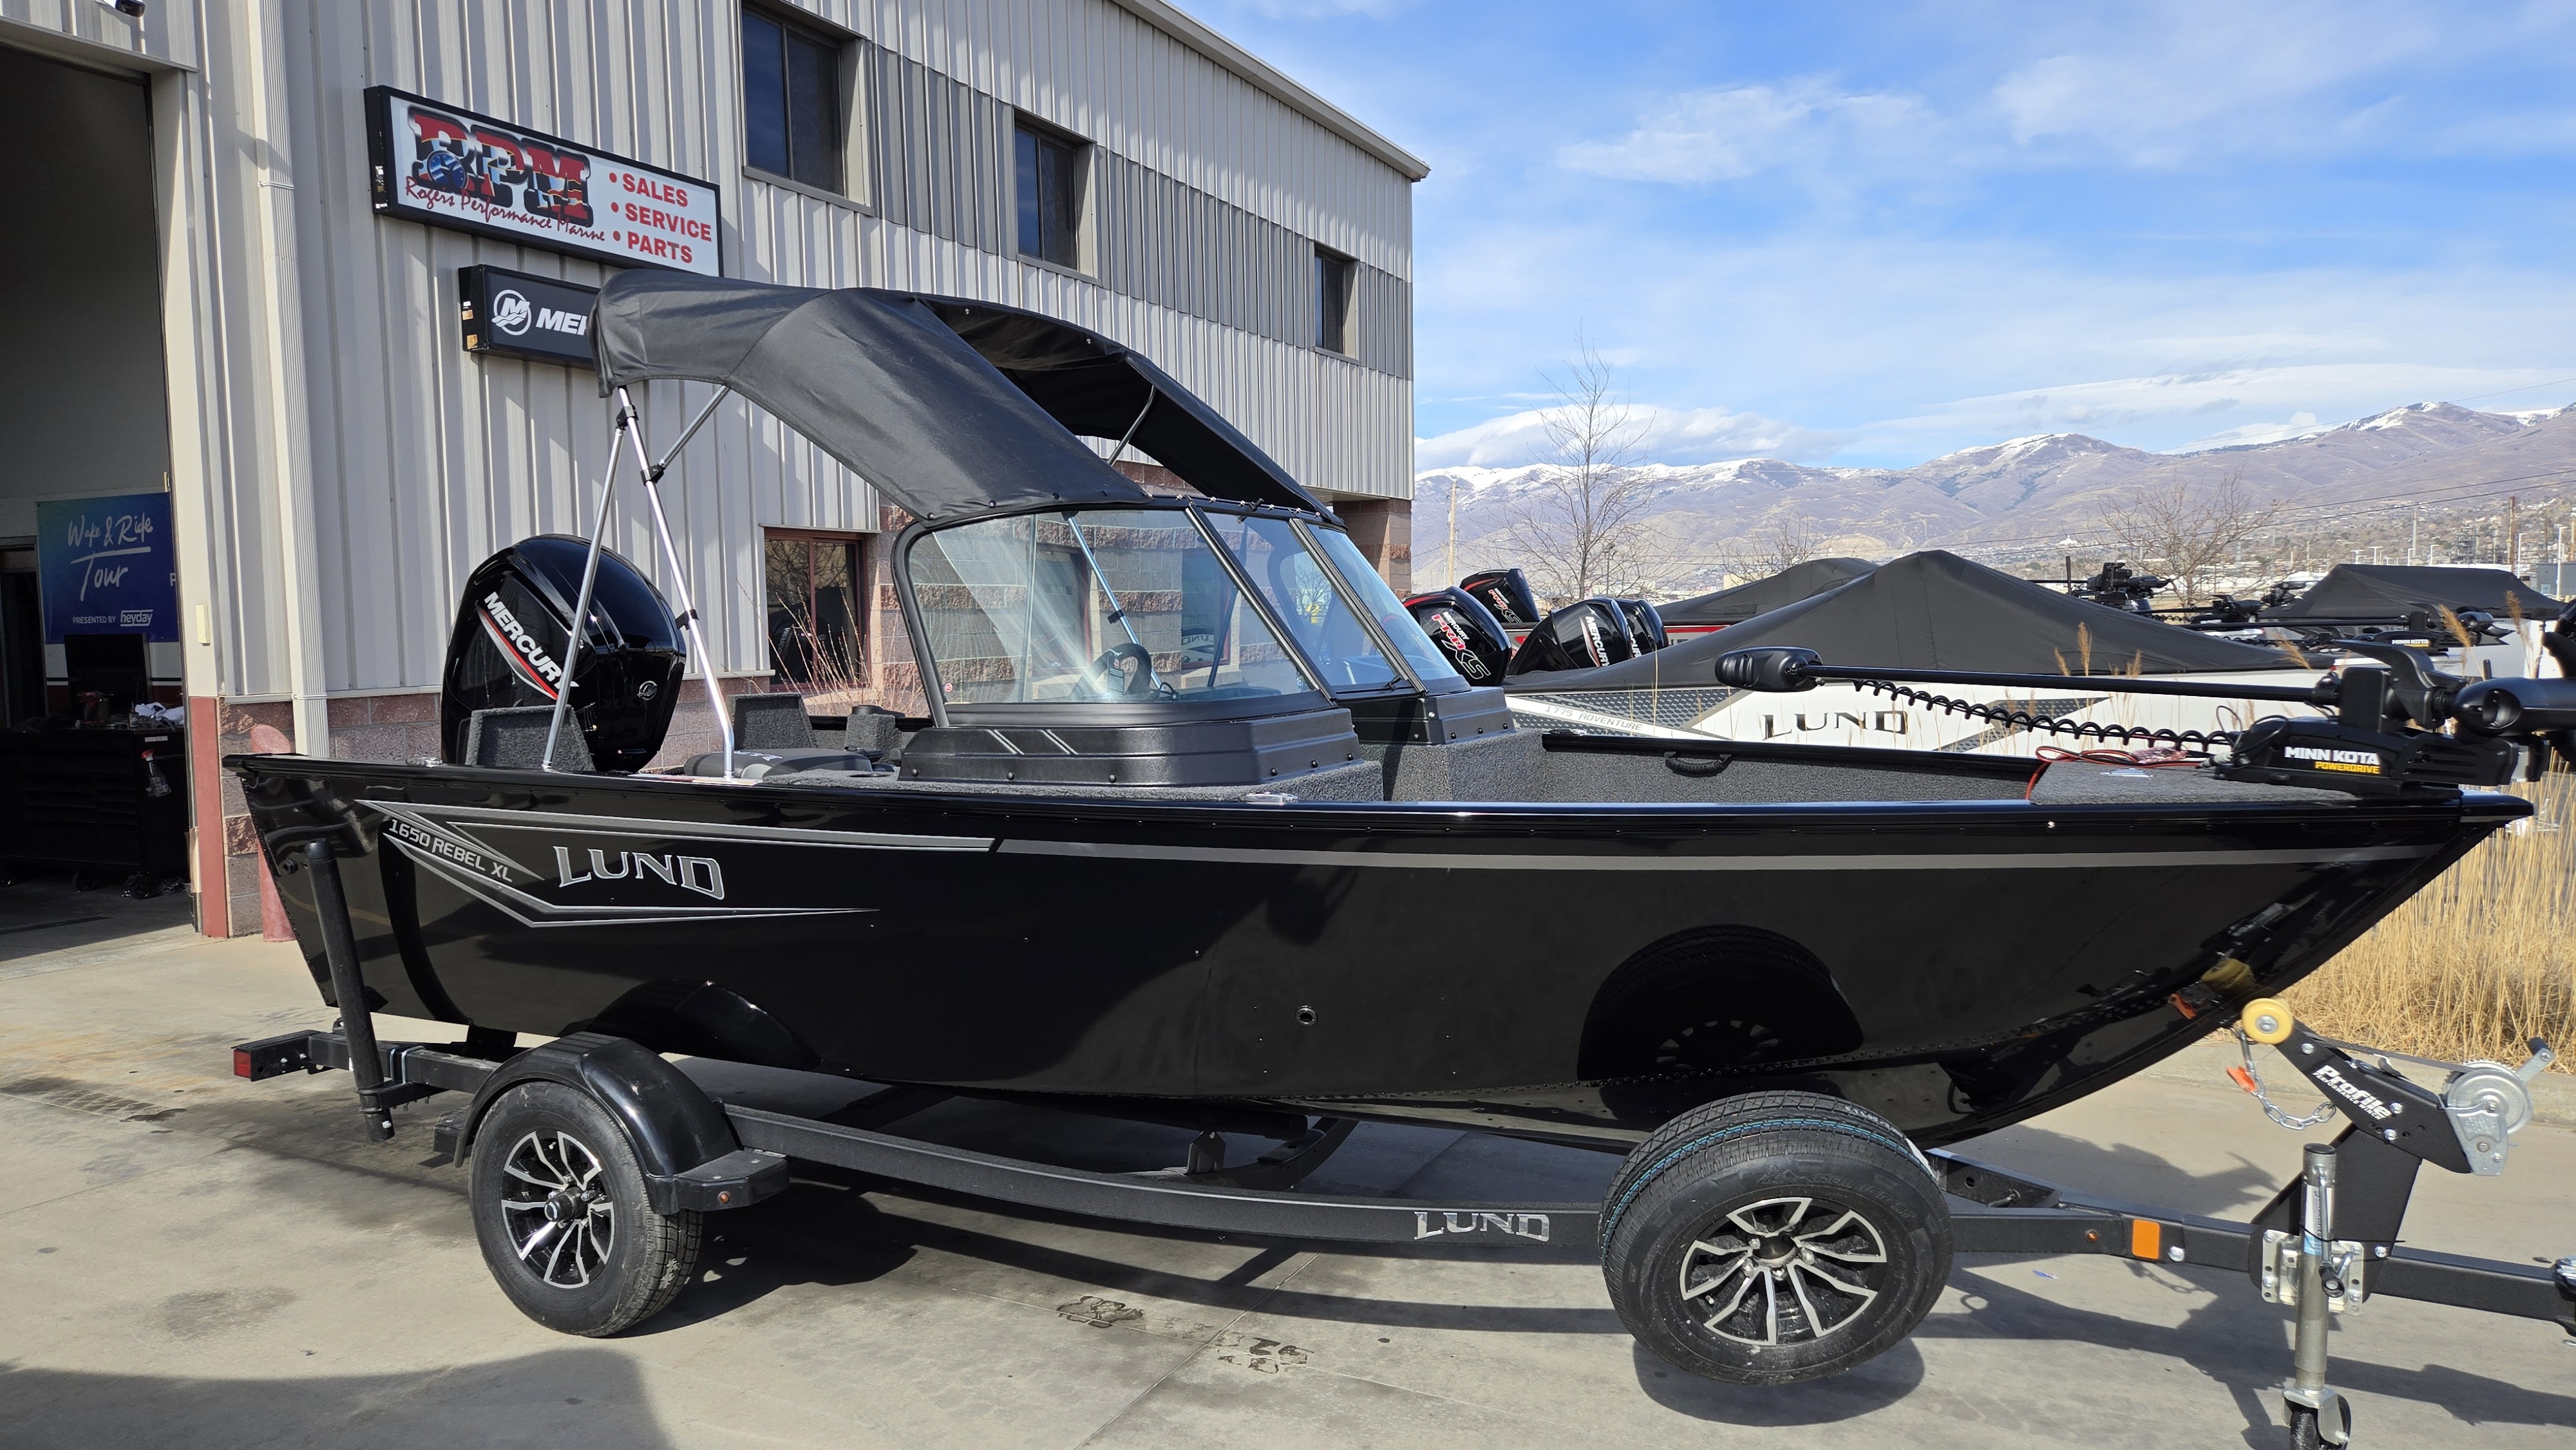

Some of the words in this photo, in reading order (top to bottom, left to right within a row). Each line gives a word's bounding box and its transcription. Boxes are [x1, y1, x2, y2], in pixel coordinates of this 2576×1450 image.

[408, 106, 594, 227] RPM
[623, 173, 688, 207] SALES
[460, 188, 553, 230] Performance
[557, 218, 605, 242] Marine
[625, 202, 712, 242] SERVICE
[628, 231, 693, 264] PARTS
[68, 515, 102, 547] Wake
[104, 516, 114, 547] &
[115, 512, 154, 546] Ride
[71, 547, 151, 601] Tour
[120, 610, 153, 626] heyday
[1431, 614, 1466, 650] PRO
[1443, 611, 1470, 640] MERCURY
[1441, 639, 1492, 679] XS
[1546, 706, 1573, 717] 1775
[1578, 713, 1643, 730] ADVENTURE
[1763, 710, 1908, 741] LUND
[2284, 746, 2330, 761] MINN
[2333, 750, 2380, 766] KOTA
[2315, 761, 2381, 774] POWERDRIVE
[389, 819, 430, 847] 1650
[432, 838, 485, 871] REBEL
[491, 862, 513, 882] XL
[554, 845, 725, 900] LUND
[2313, 1072, 2360, 1104] PERFORMANCE
[2358, 1104, 2382, 1120] WINCH
[2316, 1065, 2392, 1118] Profile
[1414, 1211, 1549, 1242] LUND
